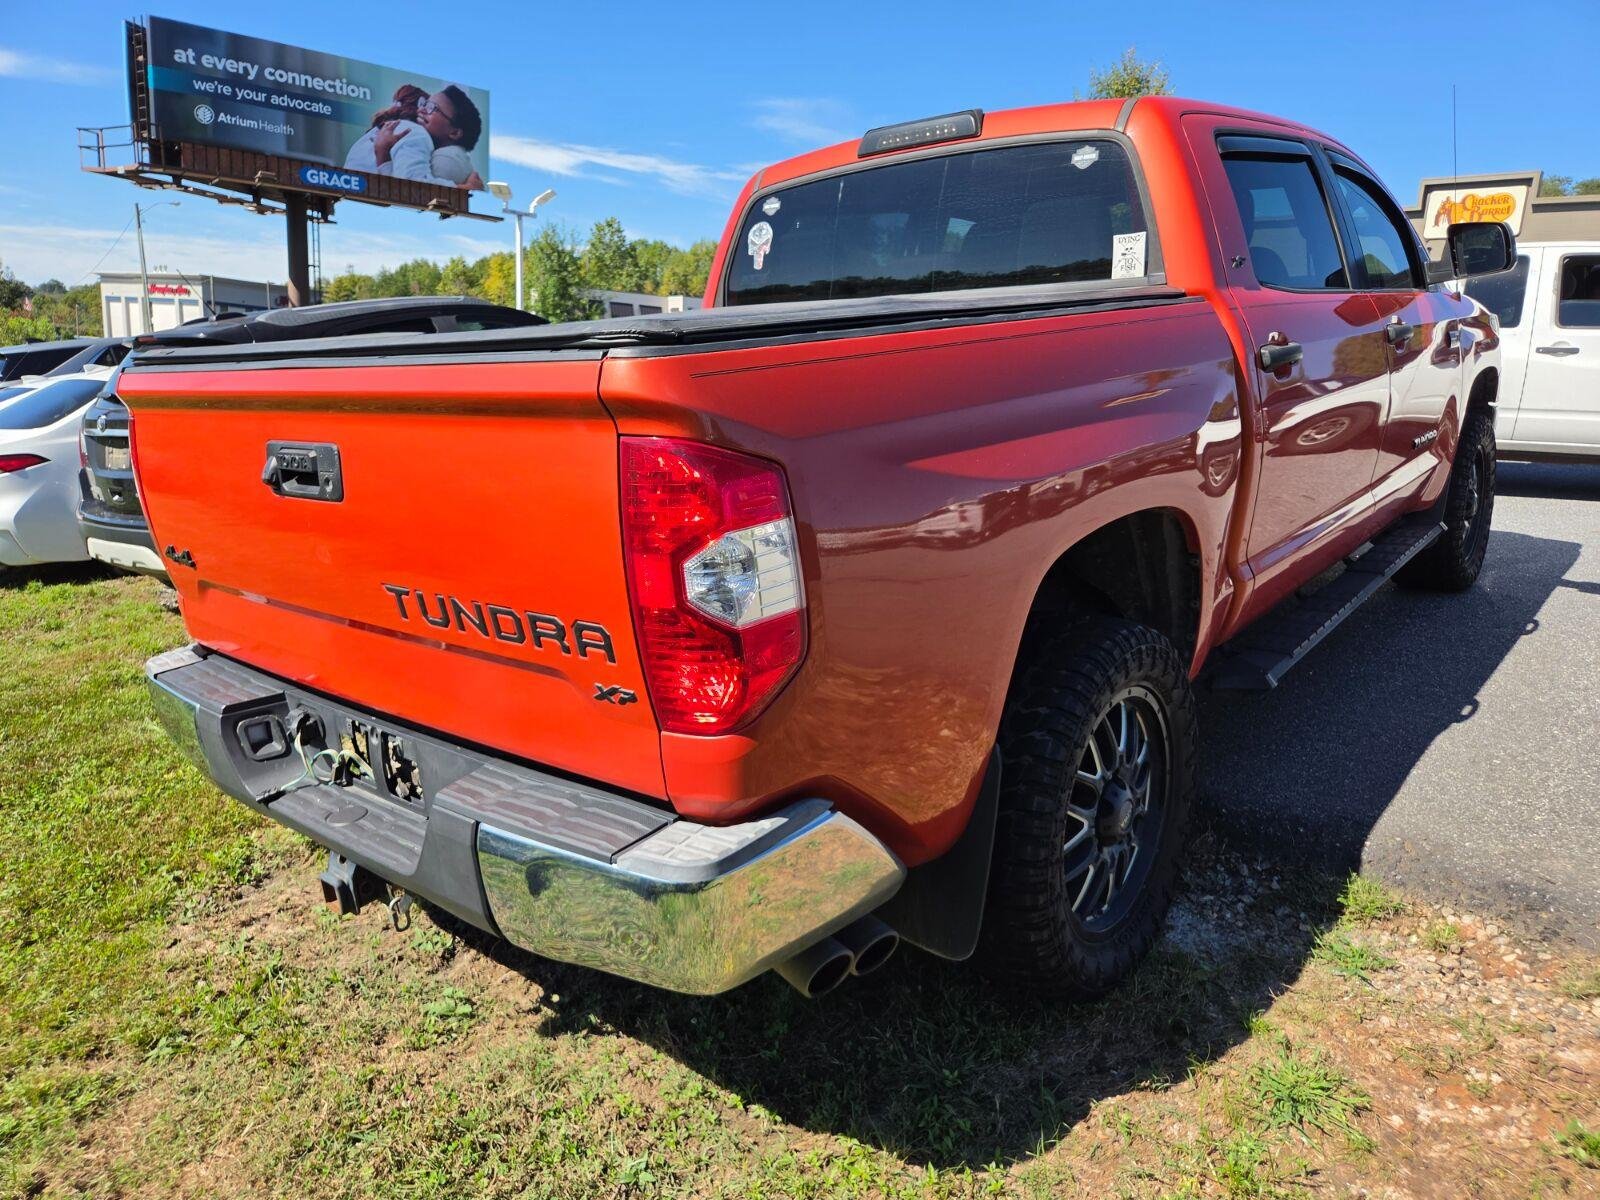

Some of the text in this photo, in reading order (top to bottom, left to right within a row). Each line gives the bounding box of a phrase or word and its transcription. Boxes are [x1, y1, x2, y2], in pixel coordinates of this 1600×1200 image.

[173, 48, 371, 100] at every connection
[193, 80, 332, 115] we're your advocate
[217, 112, 294, 135] Atrium Health
[306, 169, 360, 190] GRACE
[381, 583, 617, 665] TUNDRA
[593, 682, 638, 705] XP
